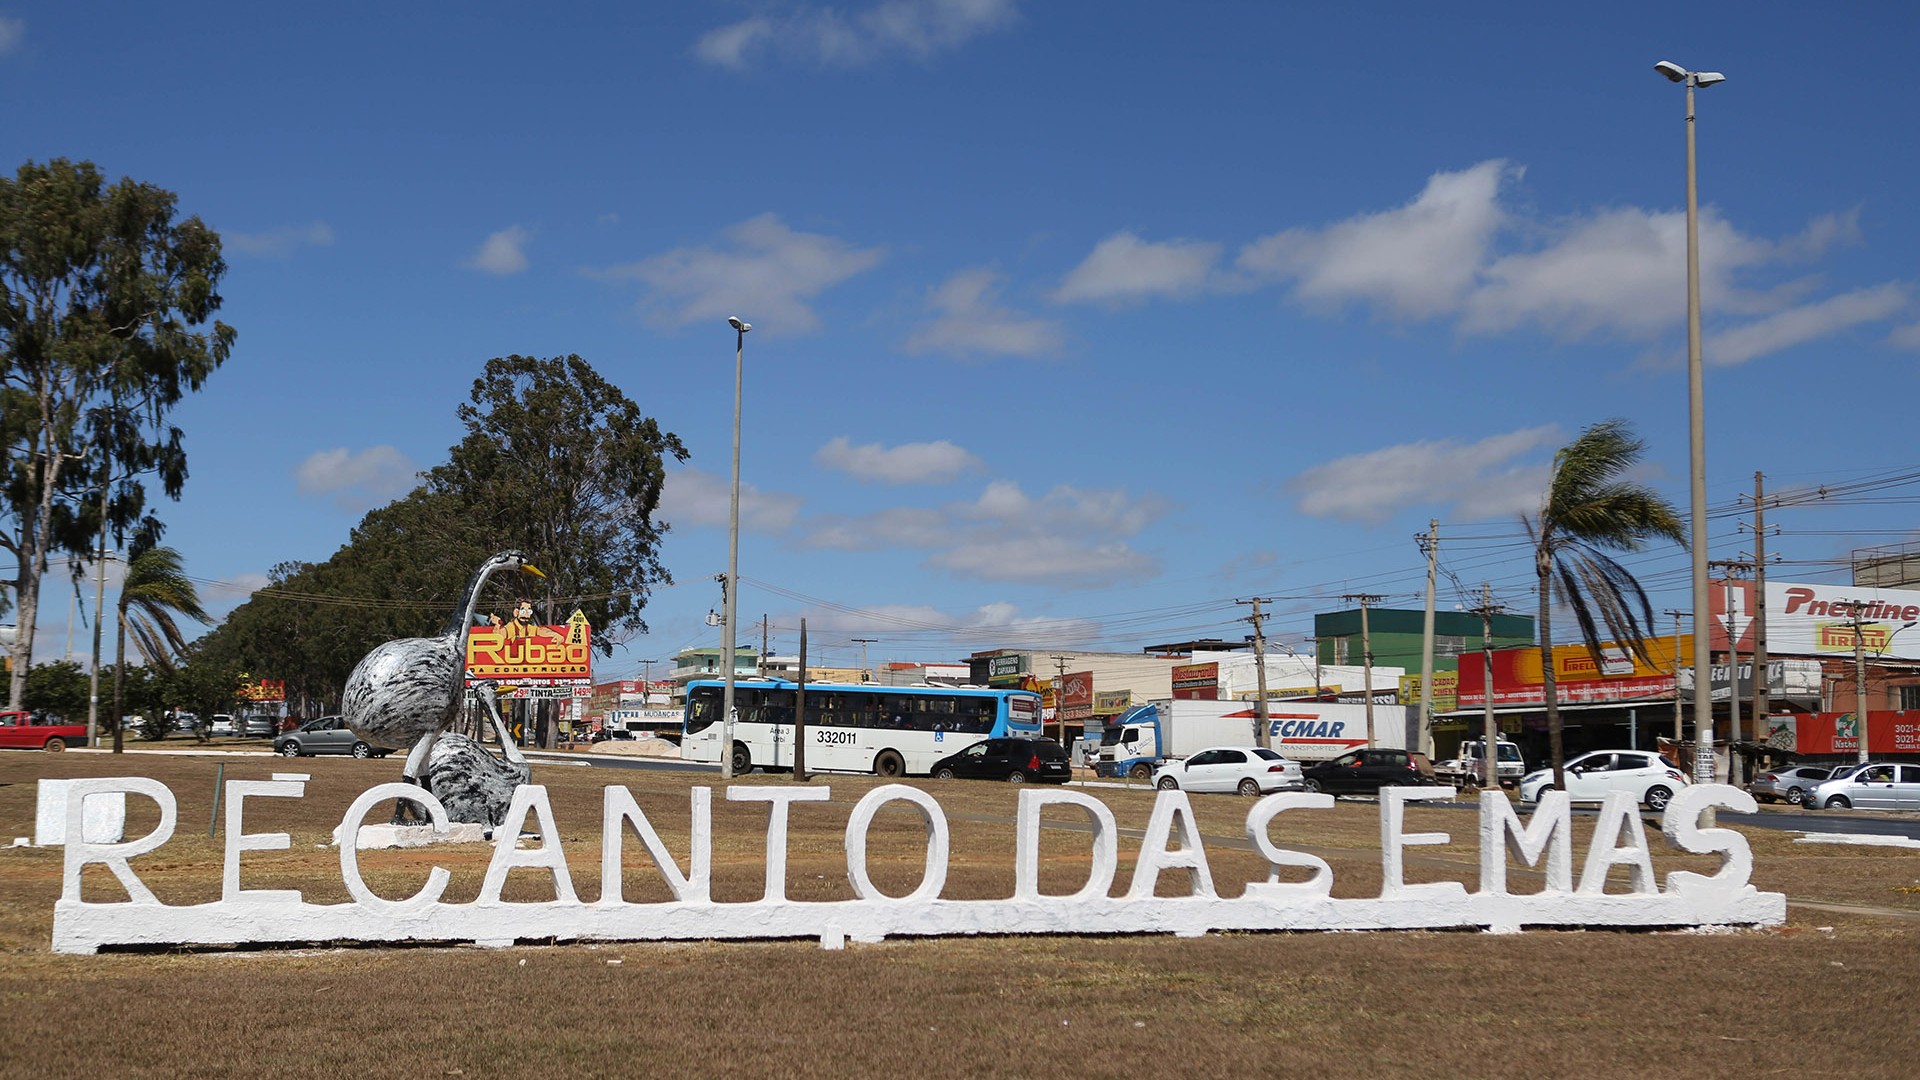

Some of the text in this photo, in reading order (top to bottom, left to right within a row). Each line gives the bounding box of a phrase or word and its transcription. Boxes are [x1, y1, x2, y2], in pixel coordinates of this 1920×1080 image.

[494, 665, 587, 675] CONSTRUÇÃO
[531, 689, 552, 697] TINTA
[1268, 720, 1345, 738] ECMAR
[817, 731, 857, 744] 332011
[60, 774, 1759, 905] RECANTO DAS EMAS
